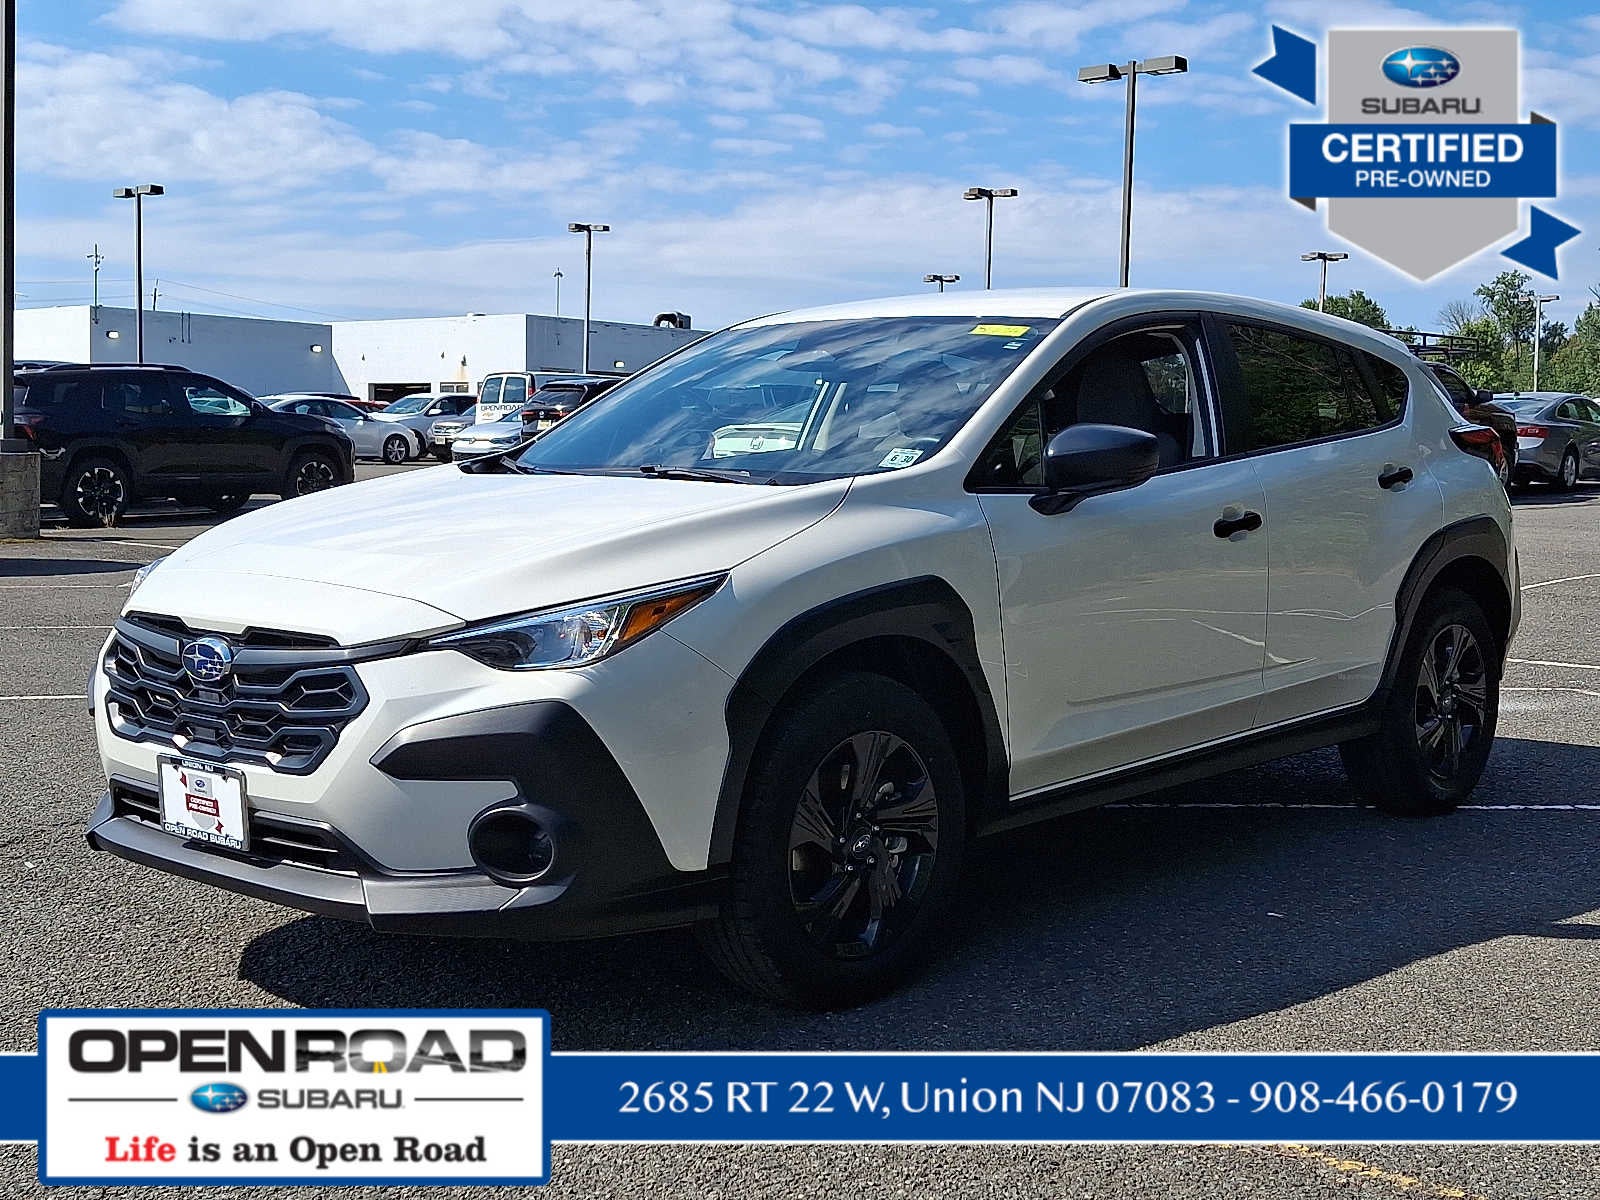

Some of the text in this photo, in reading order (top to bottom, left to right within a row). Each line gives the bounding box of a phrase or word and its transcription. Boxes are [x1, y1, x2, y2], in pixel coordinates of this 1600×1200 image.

[890, 454, 914, 463] 6 30
[165, 823, 241, 850] OPEN ROAD SUBARU
